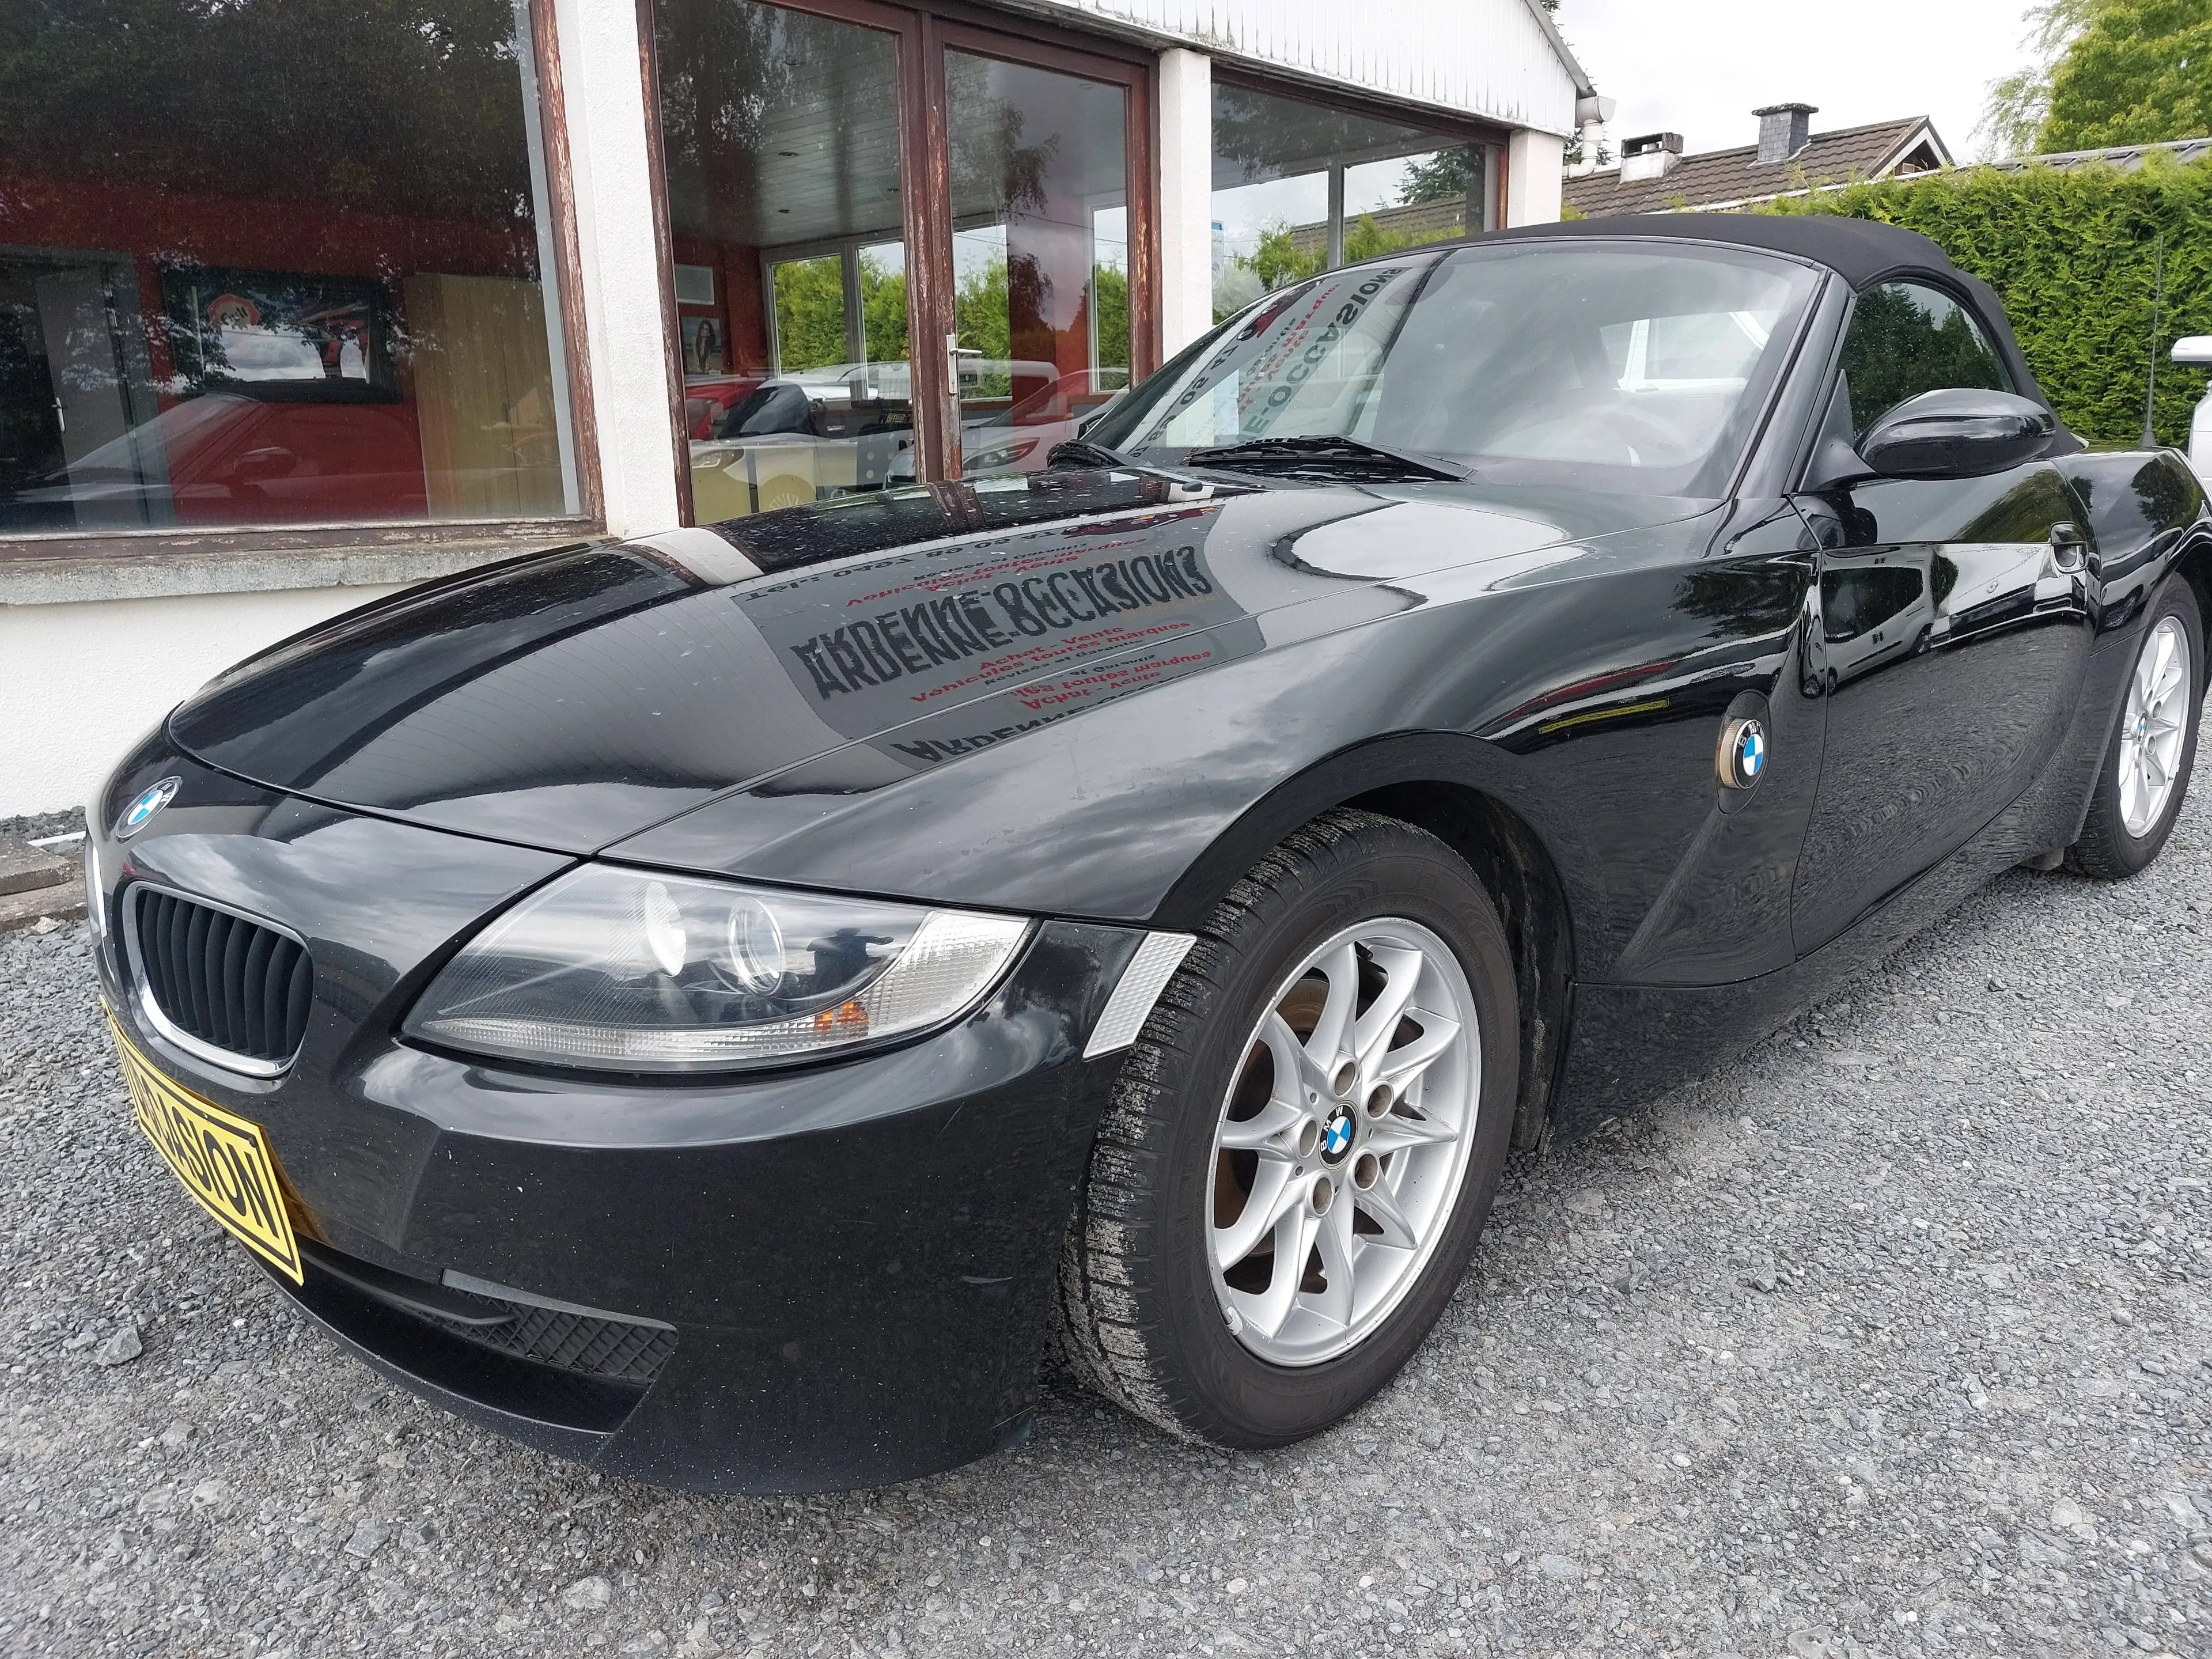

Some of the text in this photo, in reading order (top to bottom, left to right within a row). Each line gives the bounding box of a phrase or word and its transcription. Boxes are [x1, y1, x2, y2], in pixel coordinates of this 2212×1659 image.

[980, 646, 1046, 670] Achat
[1061, 626, 1124, 644] Vente
[1031, 641, 1101, 662] toutes
[1106, 622, 1190, 643] marques
[1737, 721, 1765, 749] BMW
[1320, 1105, 1344, 1153] BMW
